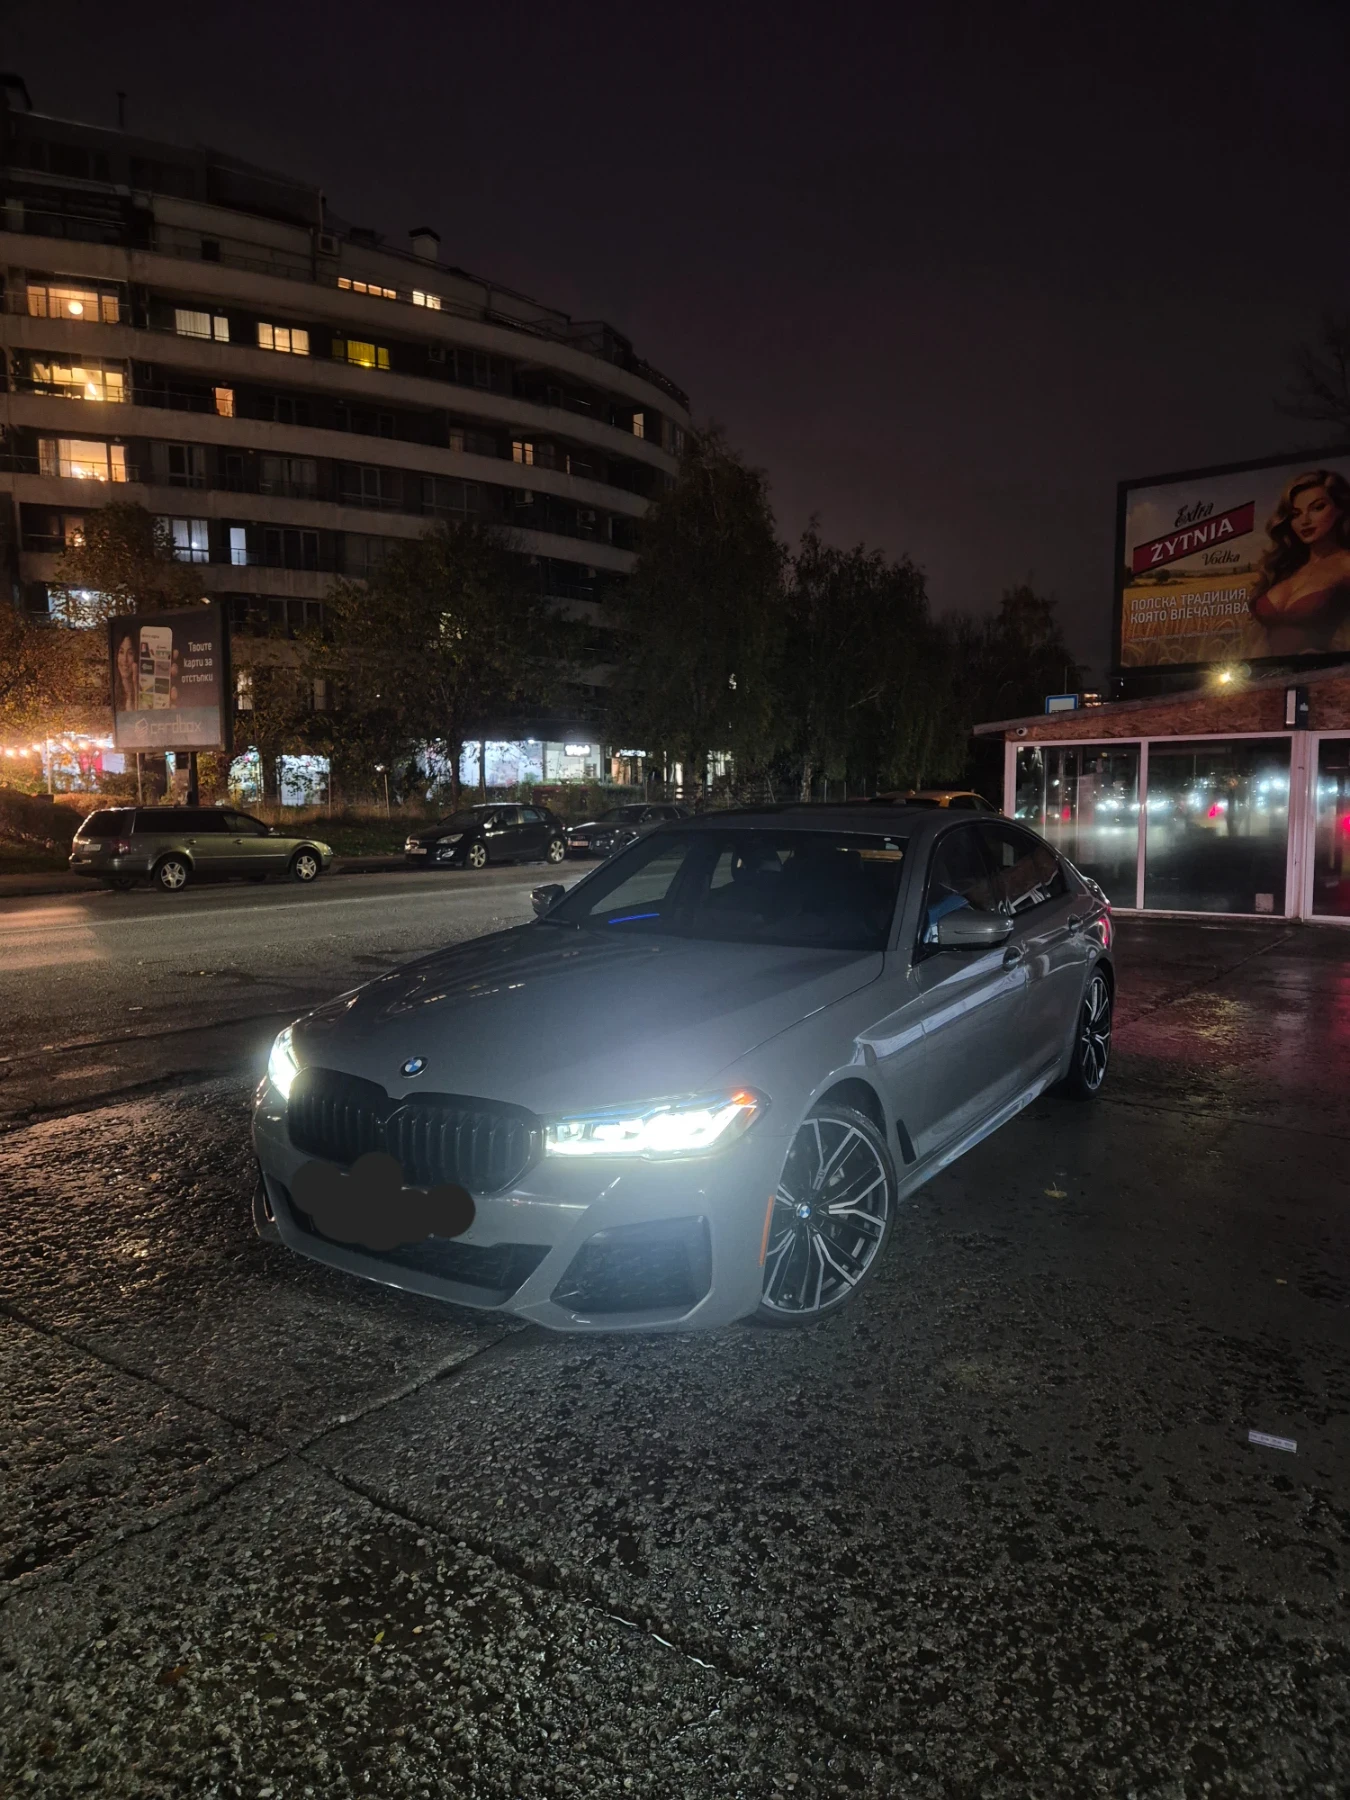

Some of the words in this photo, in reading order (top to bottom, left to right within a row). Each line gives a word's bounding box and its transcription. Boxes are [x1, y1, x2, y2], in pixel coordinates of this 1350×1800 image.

[1174, 500, 1214, 528] Extra
[1201, 549, 1240, 566] Vodka
[1131, 595, 1177, 611] ПОЛСКА
[1130, 609, 1167, 624] КОЯТО
[188, 641, 212, 652] Твоите
[183, 658, 203, 669] карти
[204, 658, 213, 667] за
[181, 673, 213, 683] отстъпки
[150, 714, 201, 734] cardbox
